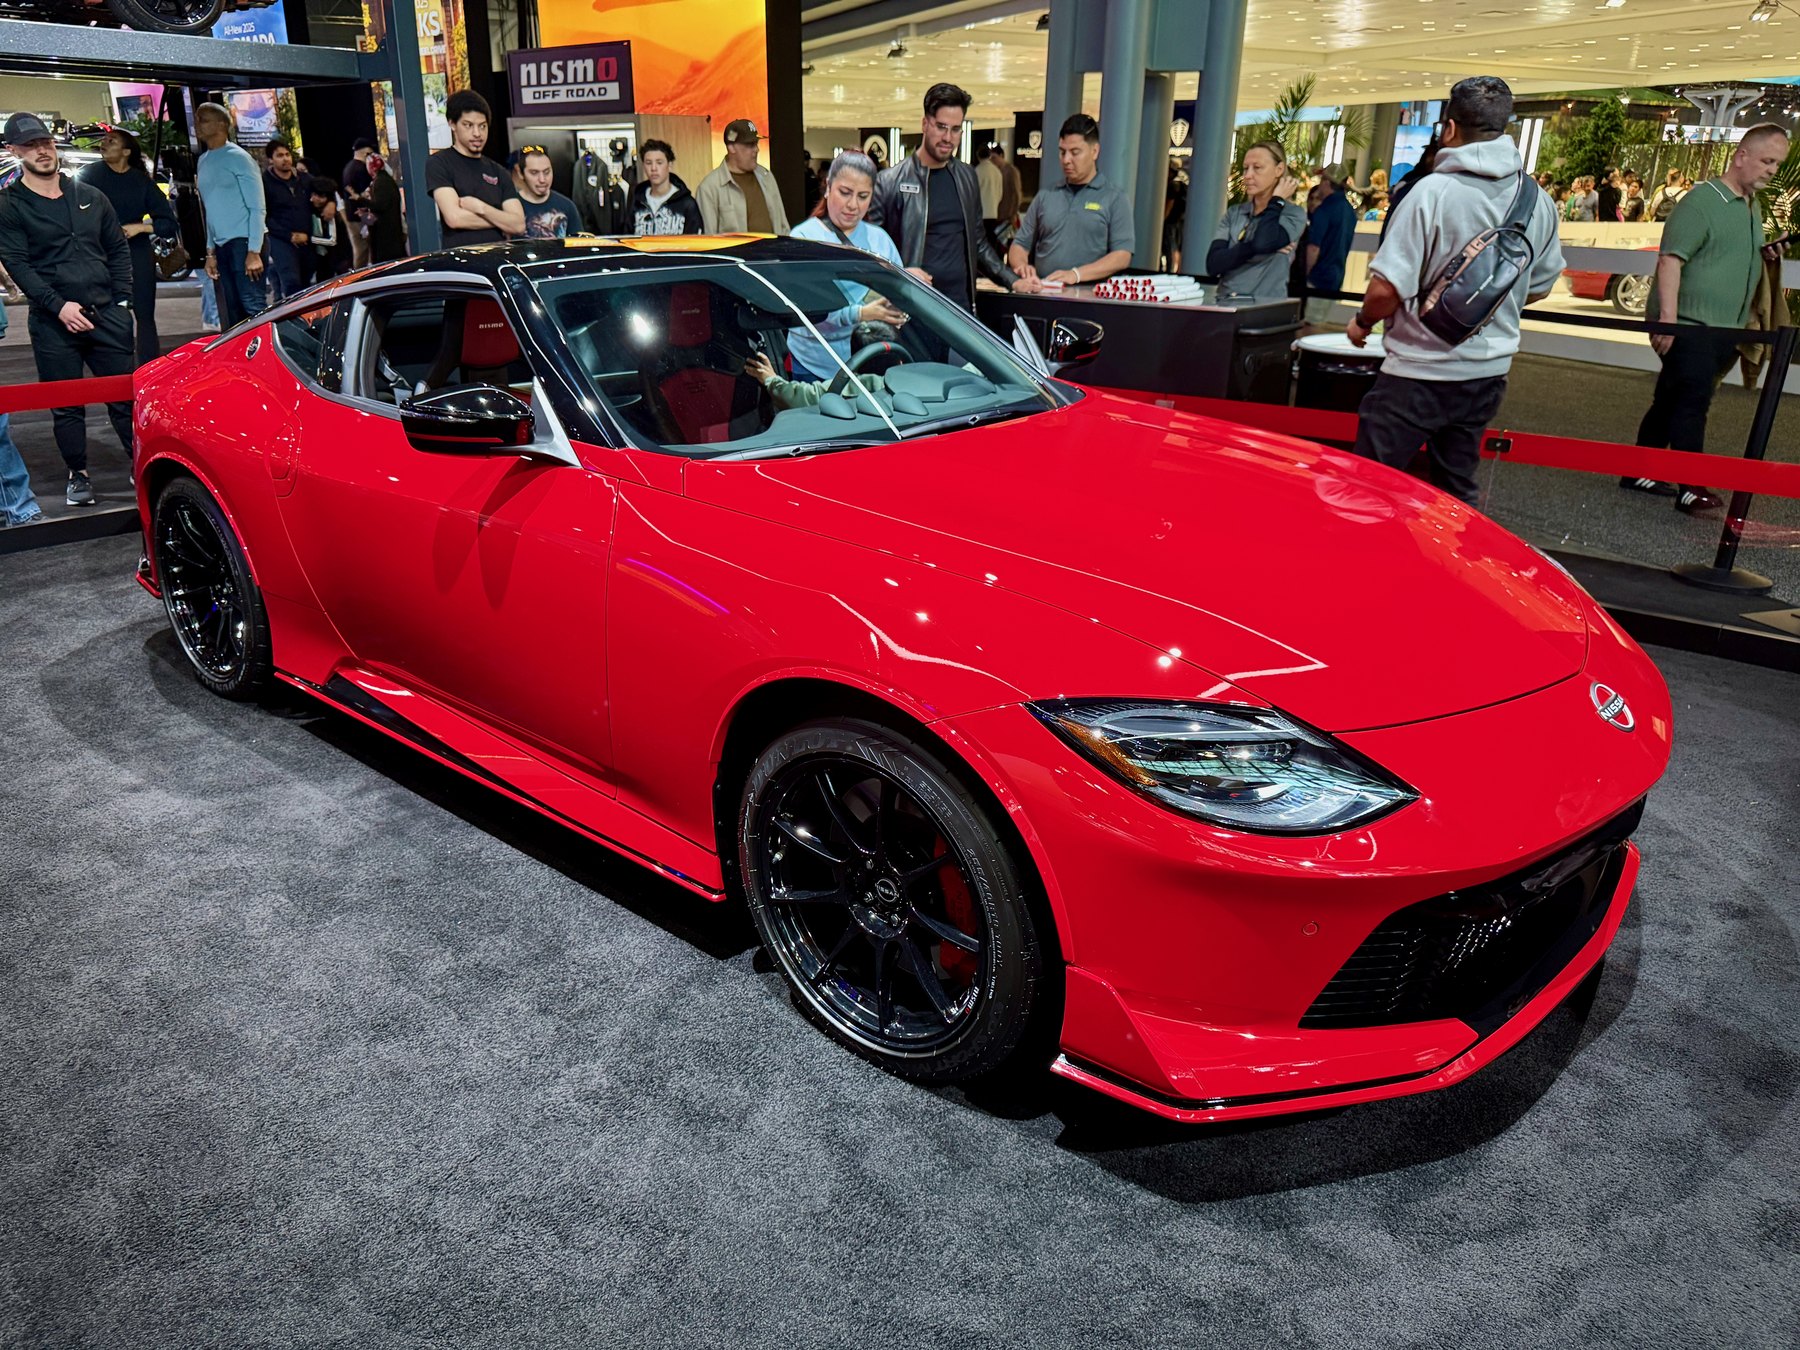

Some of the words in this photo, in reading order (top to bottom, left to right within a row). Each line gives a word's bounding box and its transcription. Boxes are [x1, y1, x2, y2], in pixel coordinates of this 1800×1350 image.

[520, 57, 618, 86] nismo
[533, 90, 560, 100] OFF
[566, 87, 607, 98] ROAD
